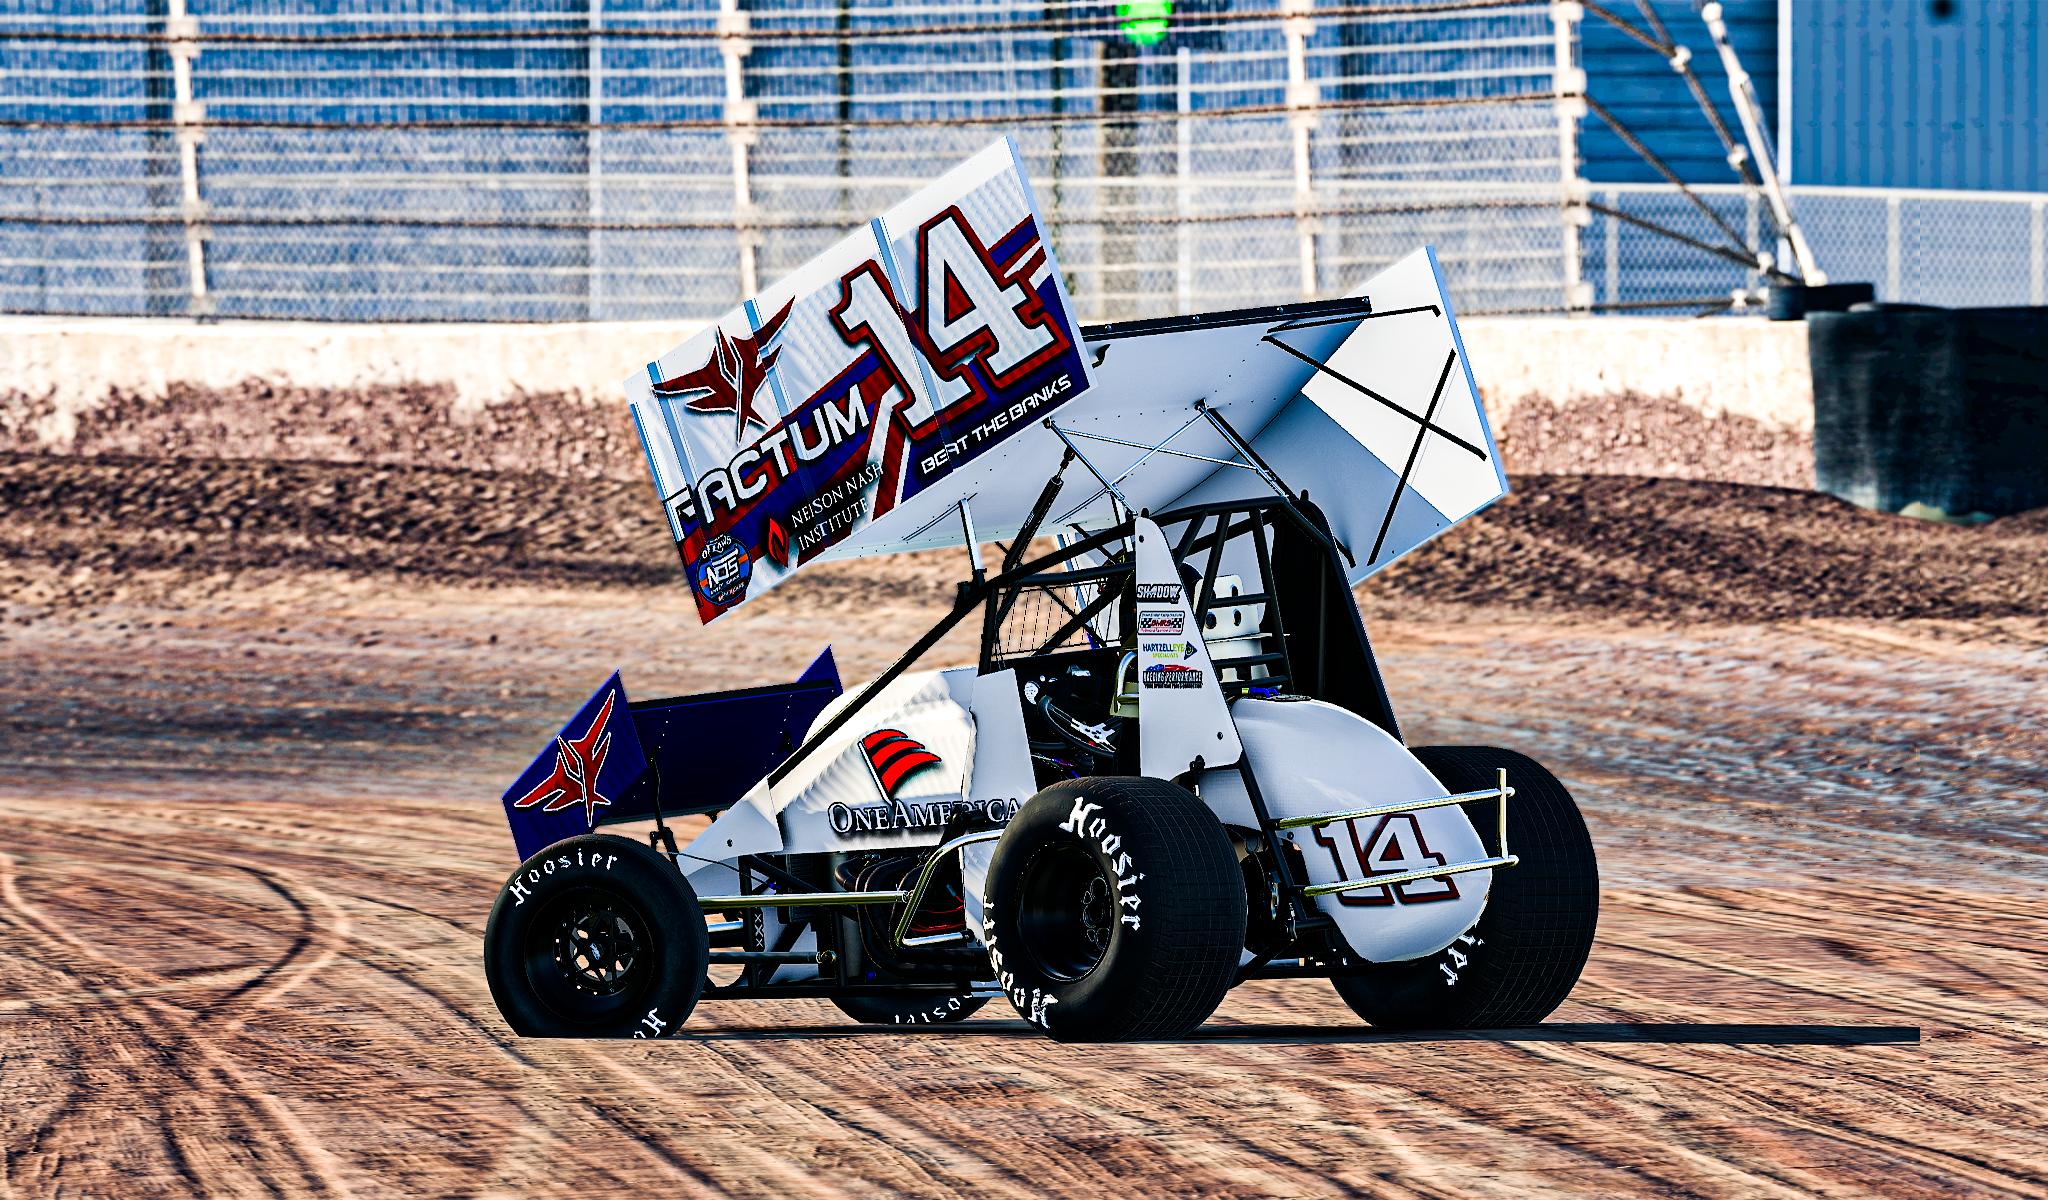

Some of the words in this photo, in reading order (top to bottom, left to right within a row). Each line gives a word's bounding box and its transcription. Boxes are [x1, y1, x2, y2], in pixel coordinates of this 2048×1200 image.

[830, 205, 1070, 440] 14
[666, 383, 870, 542] FACTUM
[921, 435, 968, 474] BEAT
[971, 412, 1009, 442] THE
[1009, 374, 1072, 421] BANKS
[798, 497, 870, 550] INSTITUTE
[845, 460, 884, 494] NASH
[706, 547, 739, 588] NOS
[508, 848, 618, 907] Hoosier
[1058, 796, 1147, 931] Hoosier
[1312, 812, 1460, 906] 14
